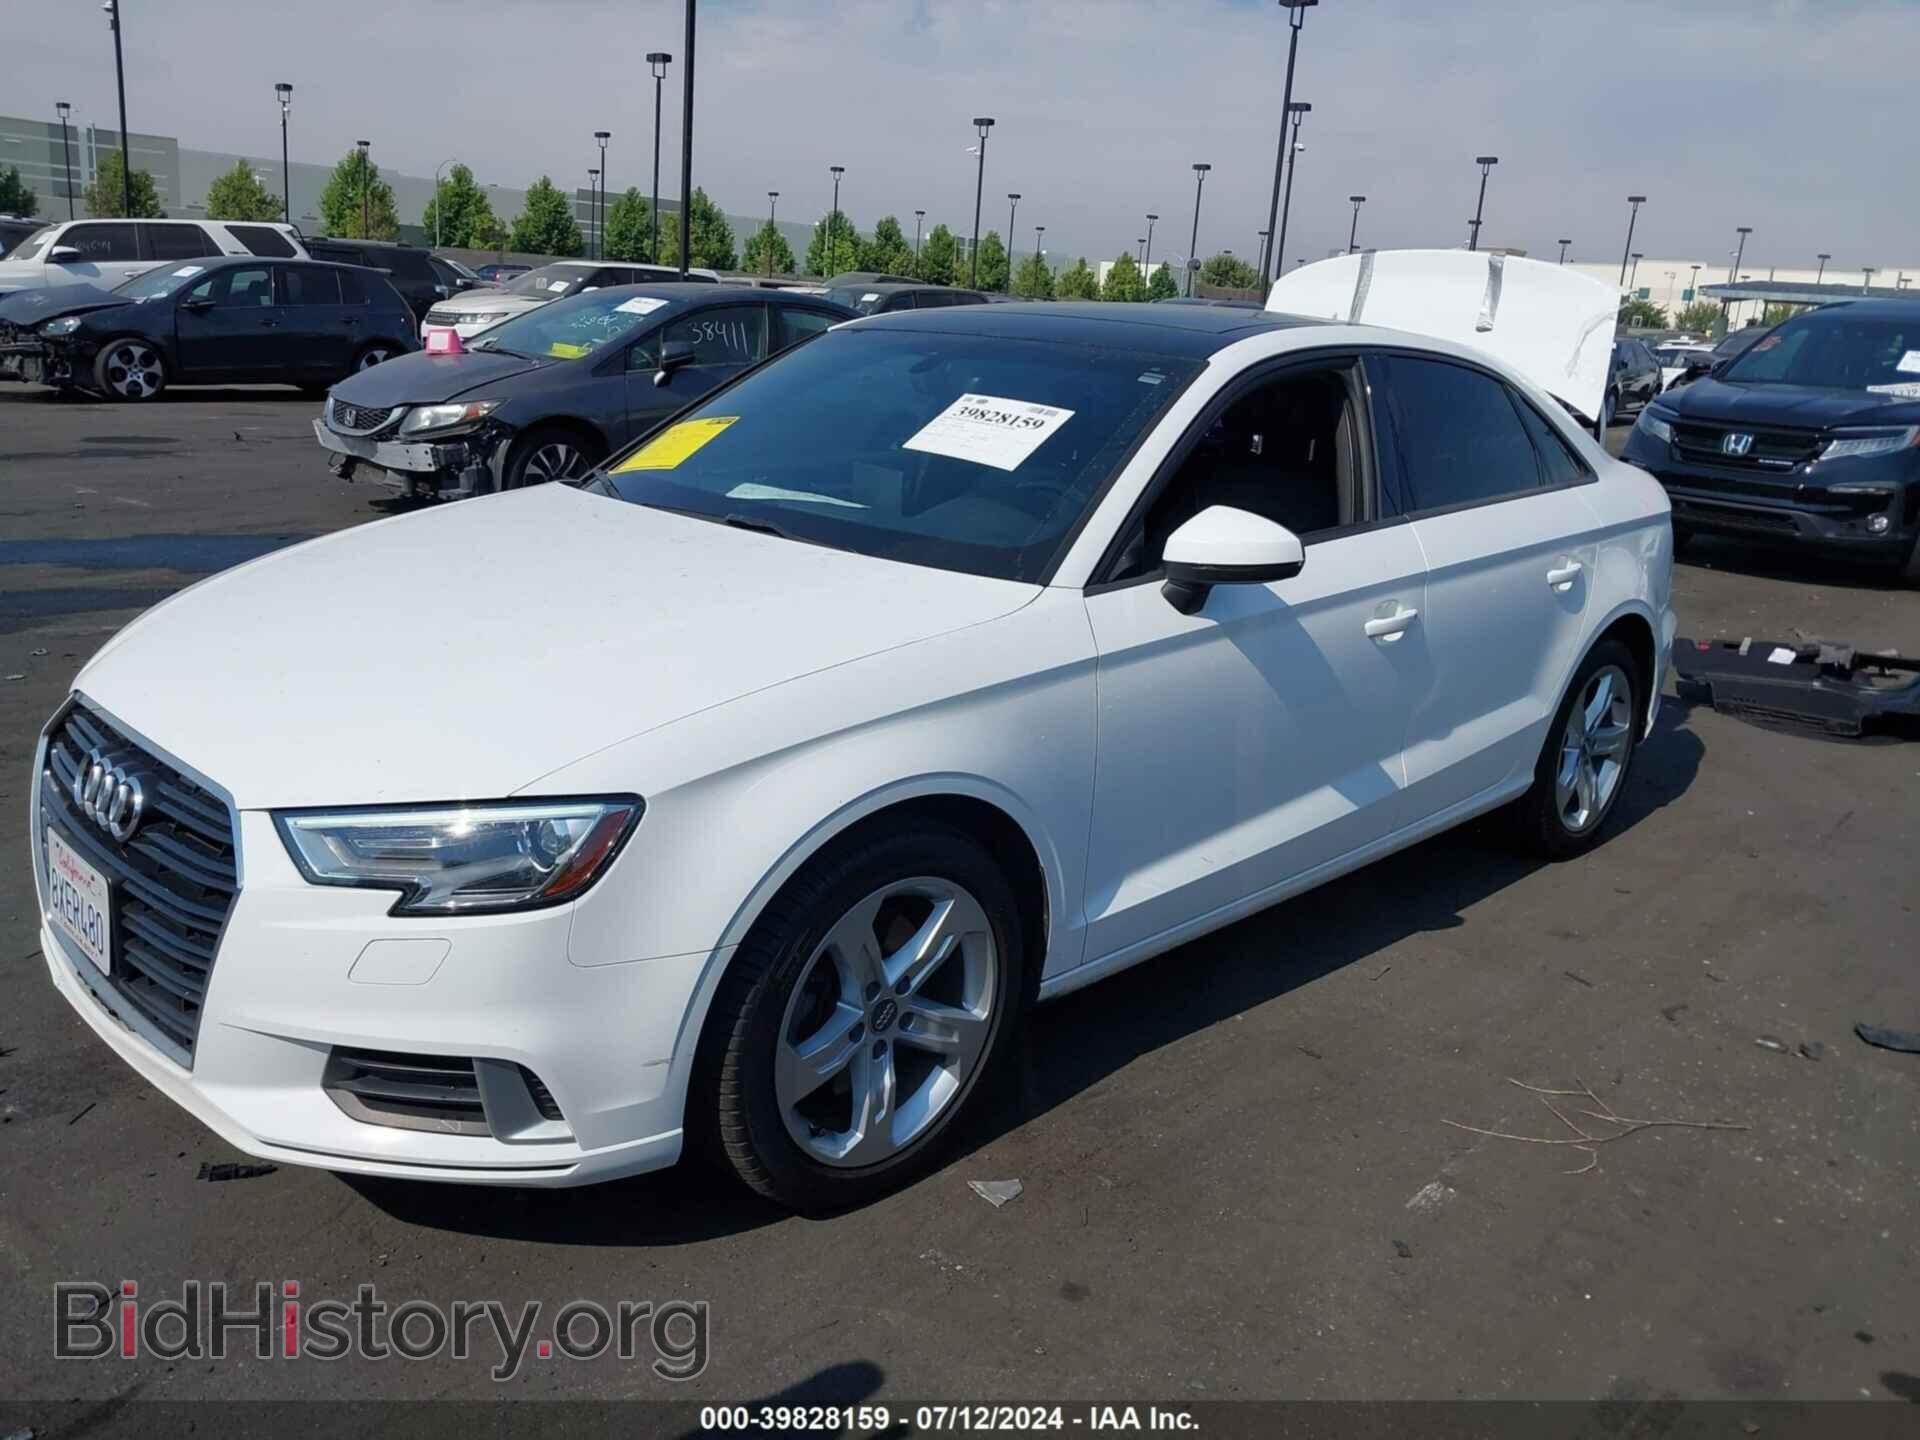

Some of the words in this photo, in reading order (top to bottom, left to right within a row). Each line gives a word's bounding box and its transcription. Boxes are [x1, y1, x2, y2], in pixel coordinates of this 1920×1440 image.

[688, 320, 749, 355] 38411
[952, 406, 1045, 430] 39828159
[51, 867, 104, 955] 8XER480
